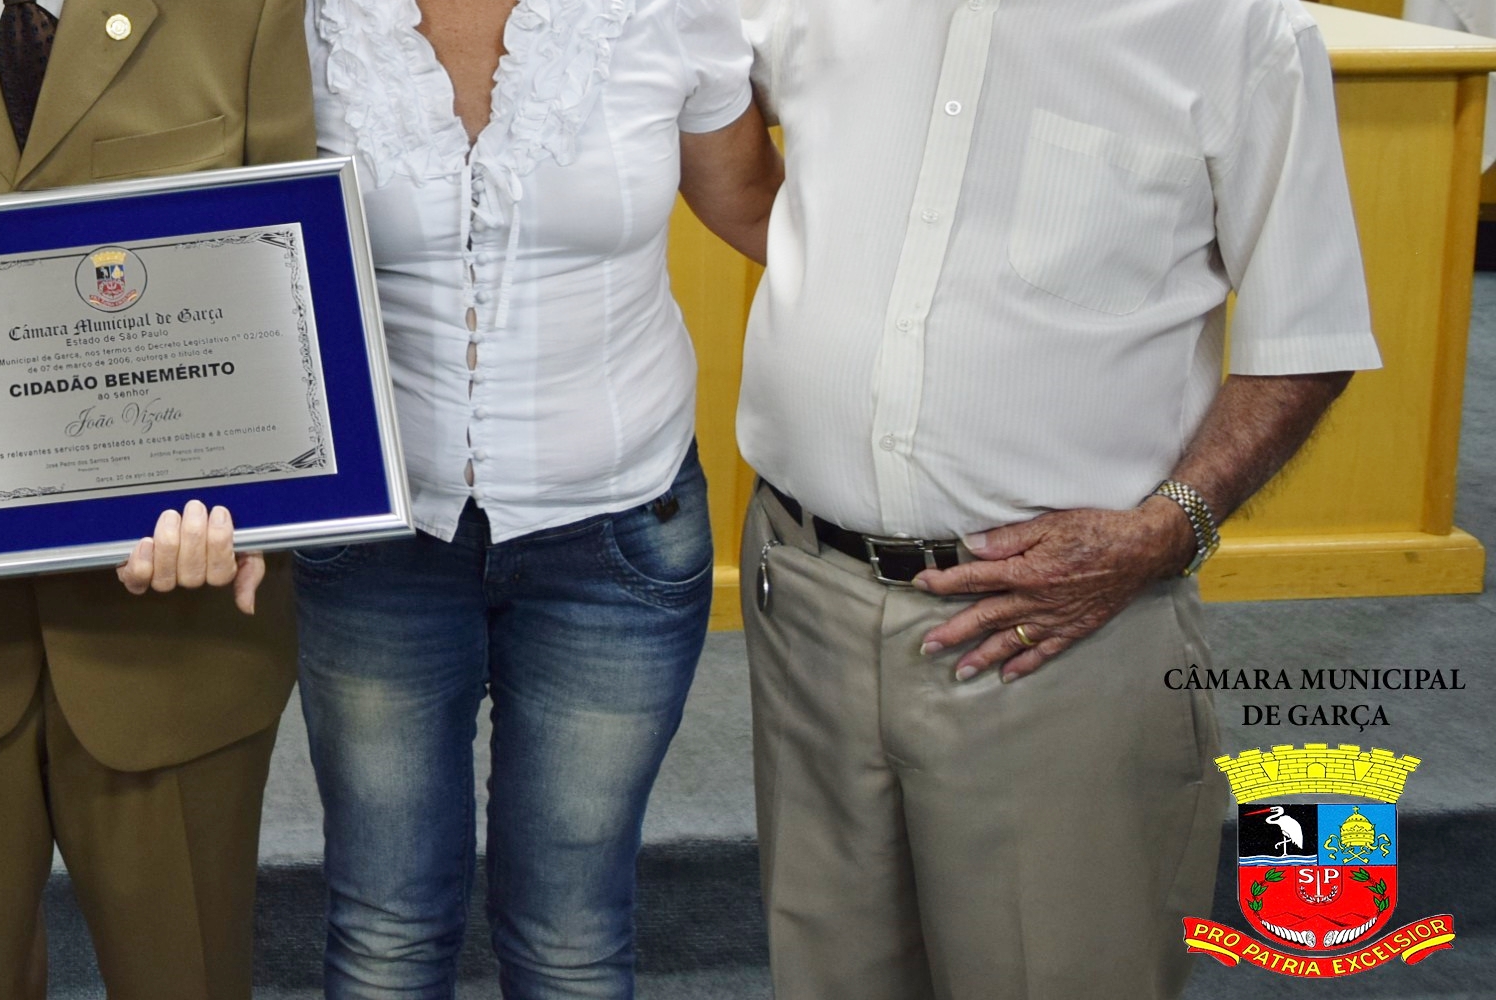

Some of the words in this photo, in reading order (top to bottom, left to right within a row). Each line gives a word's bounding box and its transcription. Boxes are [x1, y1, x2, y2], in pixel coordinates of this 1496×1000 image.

[73, 312, 152, 336] Municipal
[155, 312, 173, 326] de
[177, 307, 224, 325] Garça
[41, 353, 52, 362] de
[102, 347, 132, 356] termos
[135, 344, 146, 352] do
[147, 340, 182, 351] Decreto
[183, 335, 230, 348] Legislativo
[66, 336, 101, 347] Estado
[104, 333, 116, 343] de
[119, 330, 138, 342] São
[141, 328, 169, 339] Paulo
[27, 366, 39, 374] de
[40, 364, 51, 373] 07
[53, 363, 64, 371] de
[65, 361, 93, 369] março
[95, 359, 106, 367] de
[135, 353, 168, 362] outorga
[10, 374, 98, 397] CIDADÃO
[105, 361, 235, 388] BENEMÉRITO
[97, 393, 110, 401] ao
[113, 388, 150, 398] senhor
[64, 405, 115, 438] João
[121, 397, 184, 434] Vizotto
[7, 448, 52, 459] relevantes
[54, 443, 91, 454] serviços
[93, 439, 136, 451] prestados
[146, 436, 172, 444] causa
[174, 431, 206, 442] pública
[224, 424, 277, 436] comunidade
